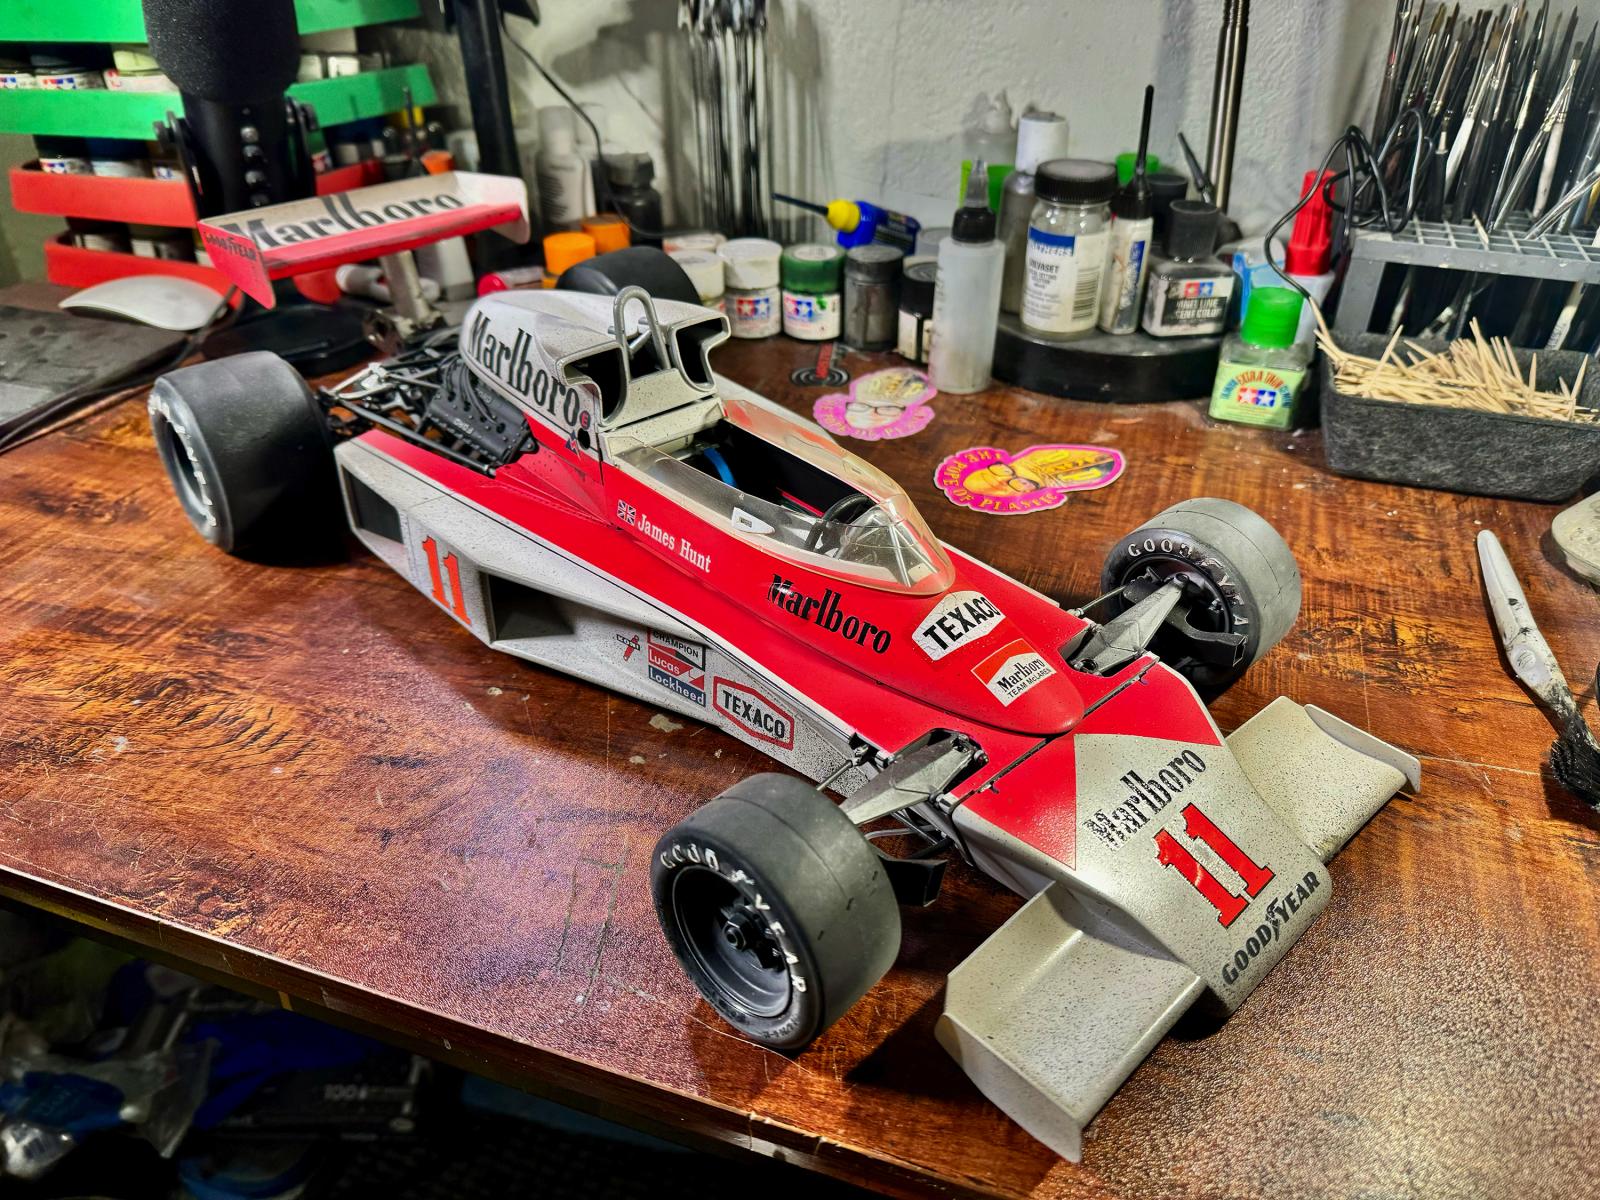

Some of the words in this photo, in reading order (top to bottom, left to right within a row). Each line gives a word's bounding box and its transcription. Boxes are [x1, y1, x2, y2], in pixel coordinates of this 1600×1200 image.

[203, 230, 257, 261] GOODYEAR
[217, 192, 465, 250] Marlboro
[468, 309, 581, 427] Marlboro
[637, 513, 675, 551] James
[679, 539, 712, 573] Hunt
[421, 534, 473, 627] 11
[766, 572, 893, 655] Marlboro
[922, 596, 1002, 651] TEXACO
[649, 650, 681, 675] Lucas
[653, 630, 700, 660] CHAMPION
[650, 671, 705, 705] Lockheed
[996, 658, 1046, 693] Marlboro
[1007, 684, 1028, 699] TEAM
[722, 689, 786, 740] TEXACO
[1082, 749, 1207, 852] Marlboro
[1152, 801, 1277, 929] 11
[1221, 870, 1321, 986] GOODYEAR
